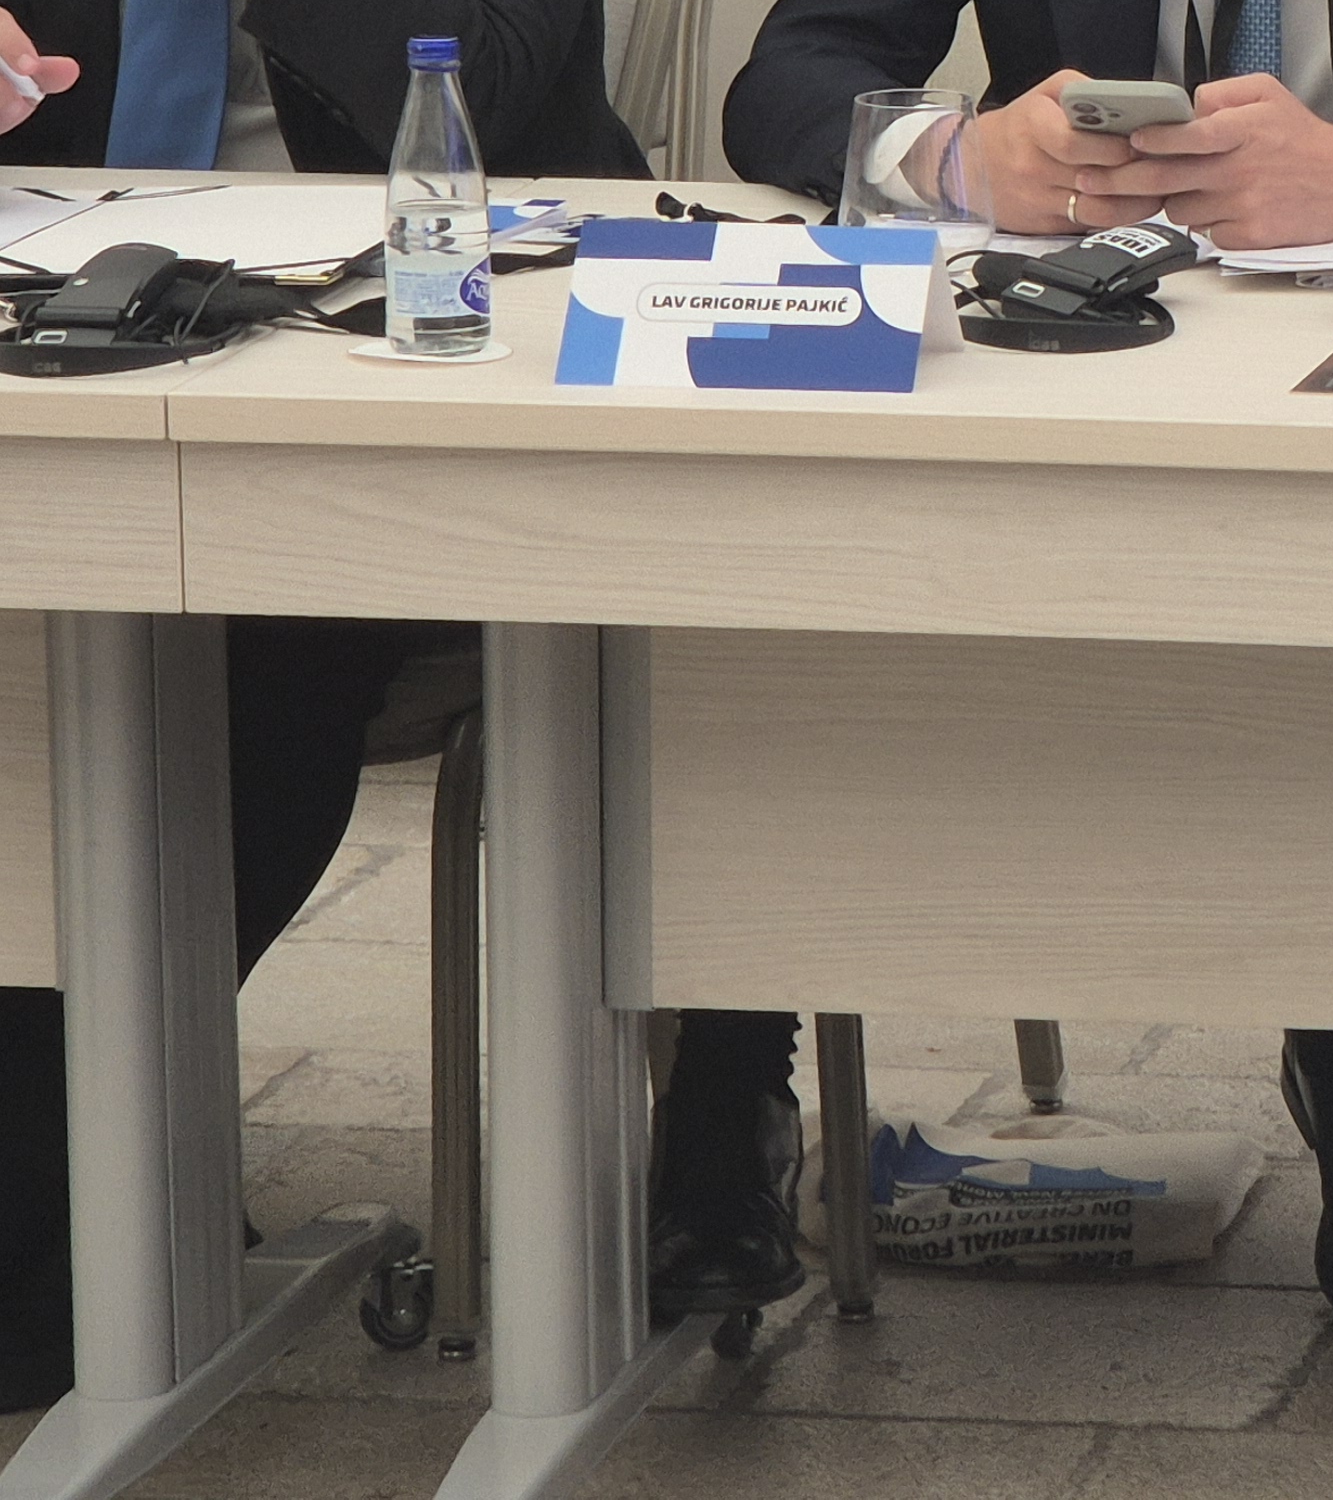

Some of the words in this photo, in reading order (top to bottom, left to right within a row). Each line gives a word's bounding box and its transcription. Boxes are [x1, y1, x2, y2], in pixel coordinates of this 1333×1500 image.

[651, 294, 686, 309] LAV
[689, 295, 781, 312] GRIGORIJE
[785, 296, 849, 314] PAJKIĆ
[958, 1222, 1134, 1256] MINISTERIAL
